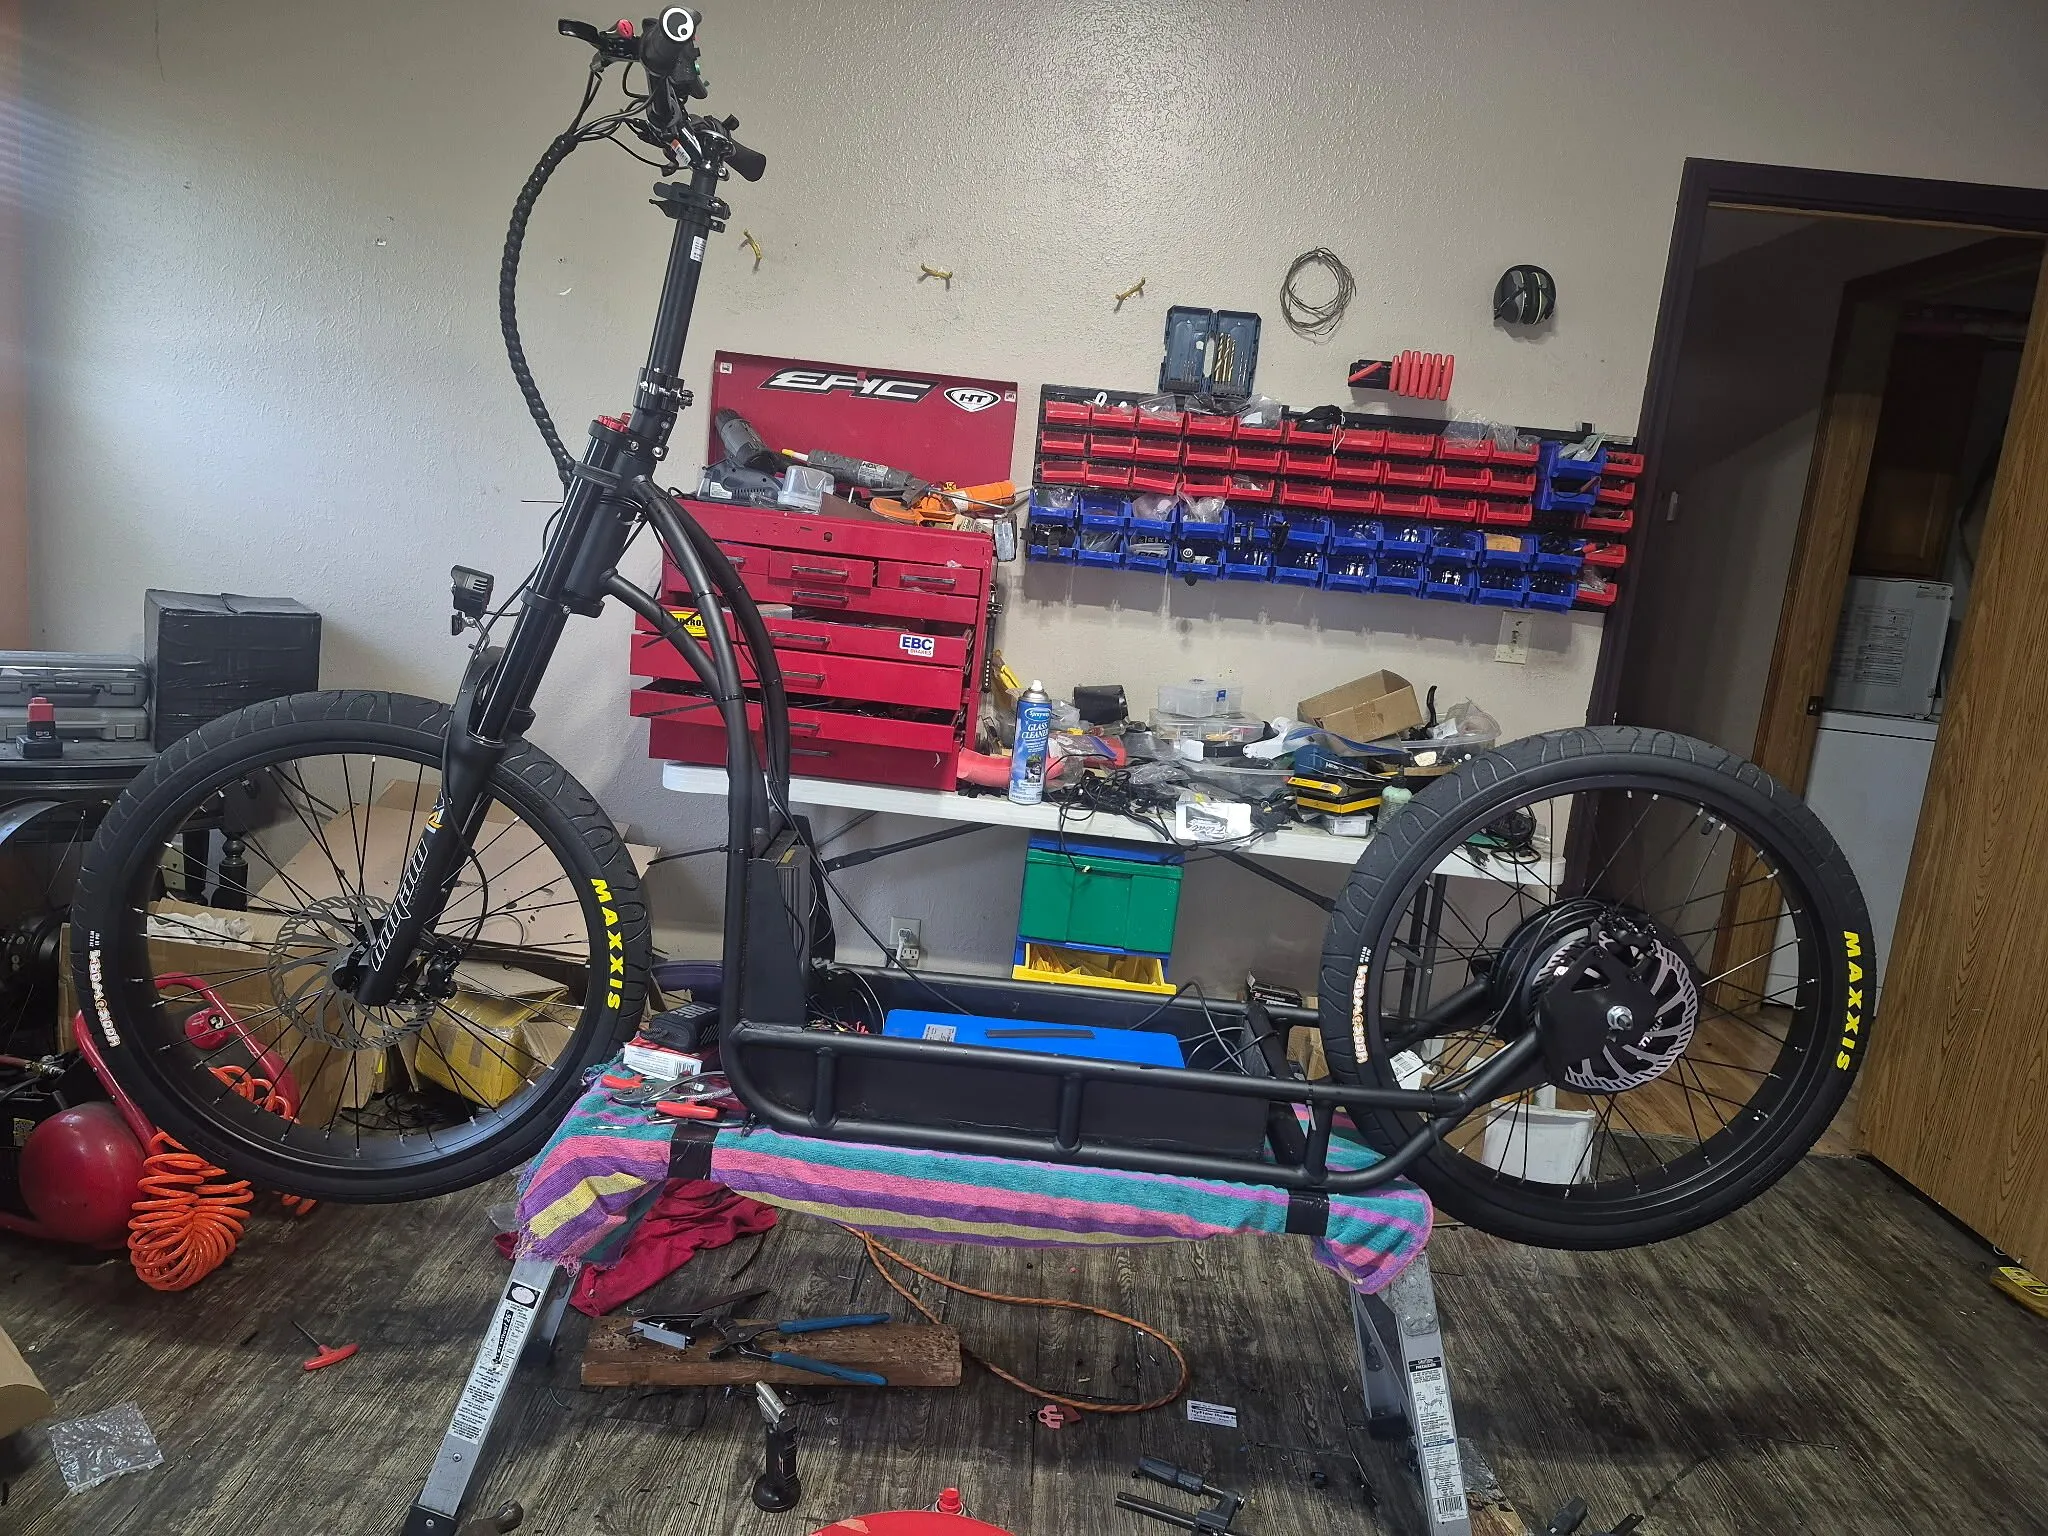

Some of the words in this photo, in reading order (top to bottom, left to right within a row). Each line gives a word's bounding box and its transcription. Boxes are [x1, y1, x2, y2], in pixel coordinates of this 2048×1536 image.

[767, 370, 933, 400] EPIC
[960, 394, 987, 402] HT
[902, 636, 932, 650] EBC
[1028, 722, 1048, 732] GLASS
[591, 878, 624, 1010] MAXXIS
[1836, 930, 1863, 1071] MAXXIS
